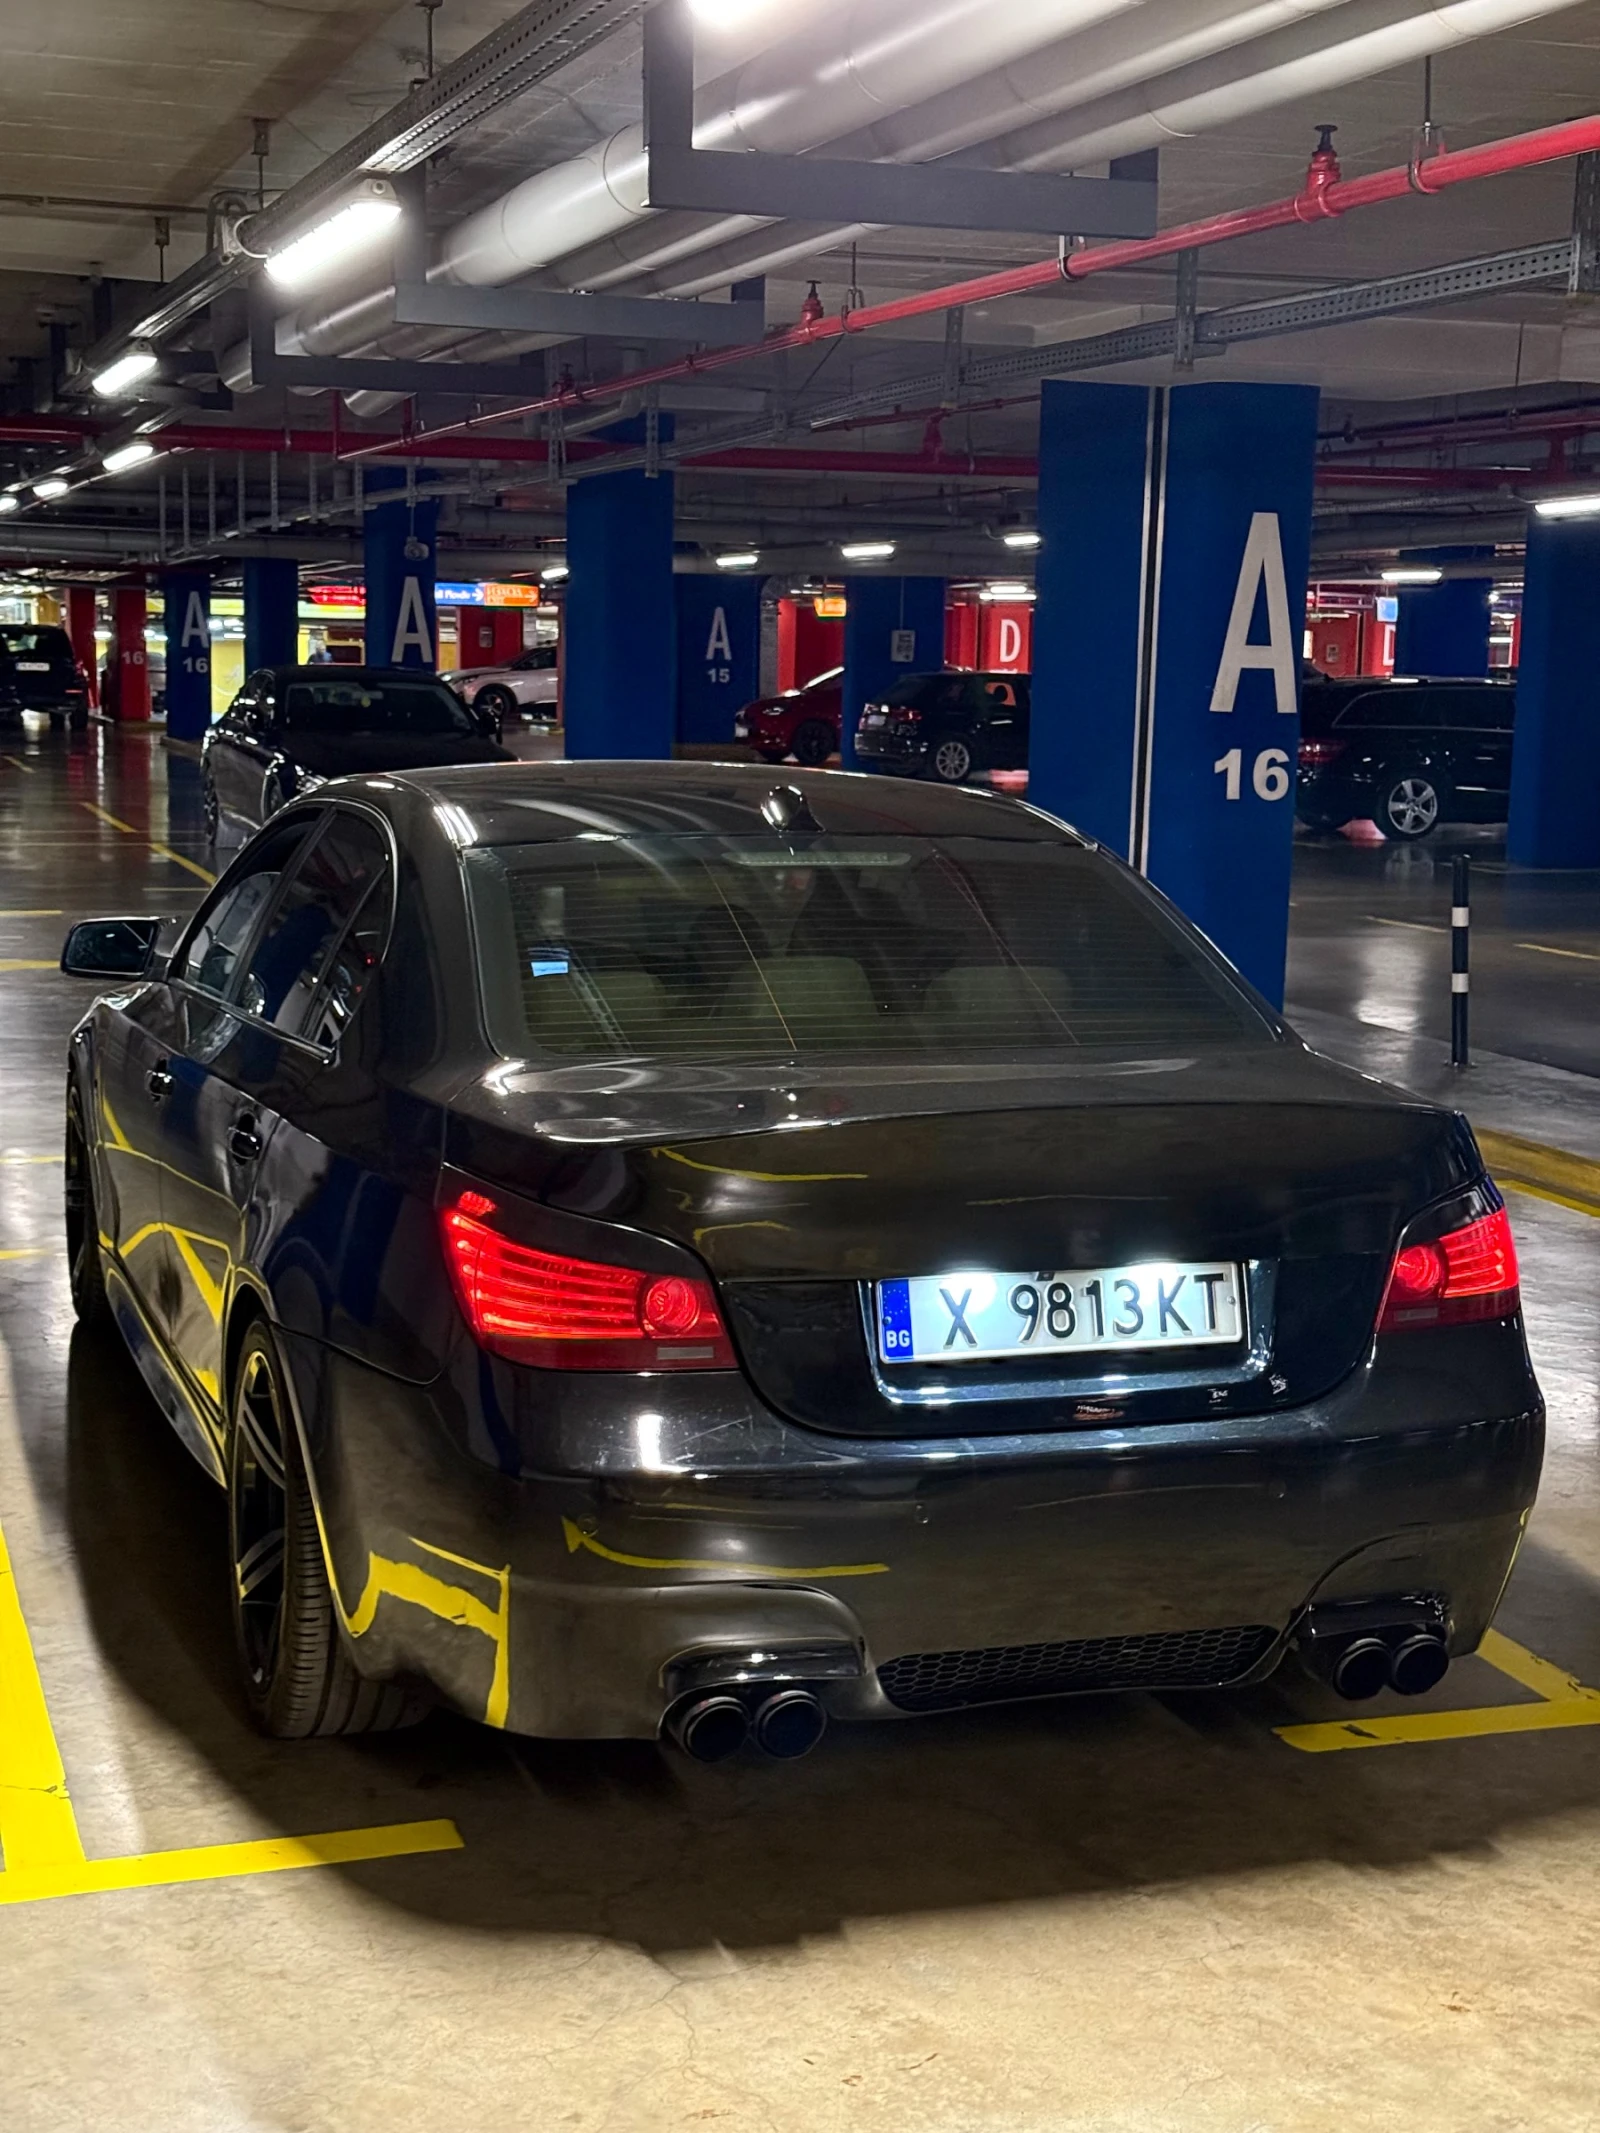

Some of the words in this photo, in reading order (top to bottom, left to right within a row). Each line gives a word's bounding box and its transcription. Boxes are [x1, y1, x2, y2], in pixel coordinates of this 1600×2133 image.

[182, 591, 211, 648] A
[391, 576, 433, 663] A
[706, 607, 732, 660] A
[1209, 512, 1297, 714] A
[122, 651, 144, 665] 16
[183, 658, 208, 673] 16
[999, 618, 1021, 663] D
[708, 668, 730, 683] 15
[1214, 748, 1289, 801] 16
[938, 1287, 977, 1348] X
[1009, 1277, 1143, 1341] 9813
[1158, 1272, 1225, 1336] KT
[886, 1330, 910, 1348] BG
